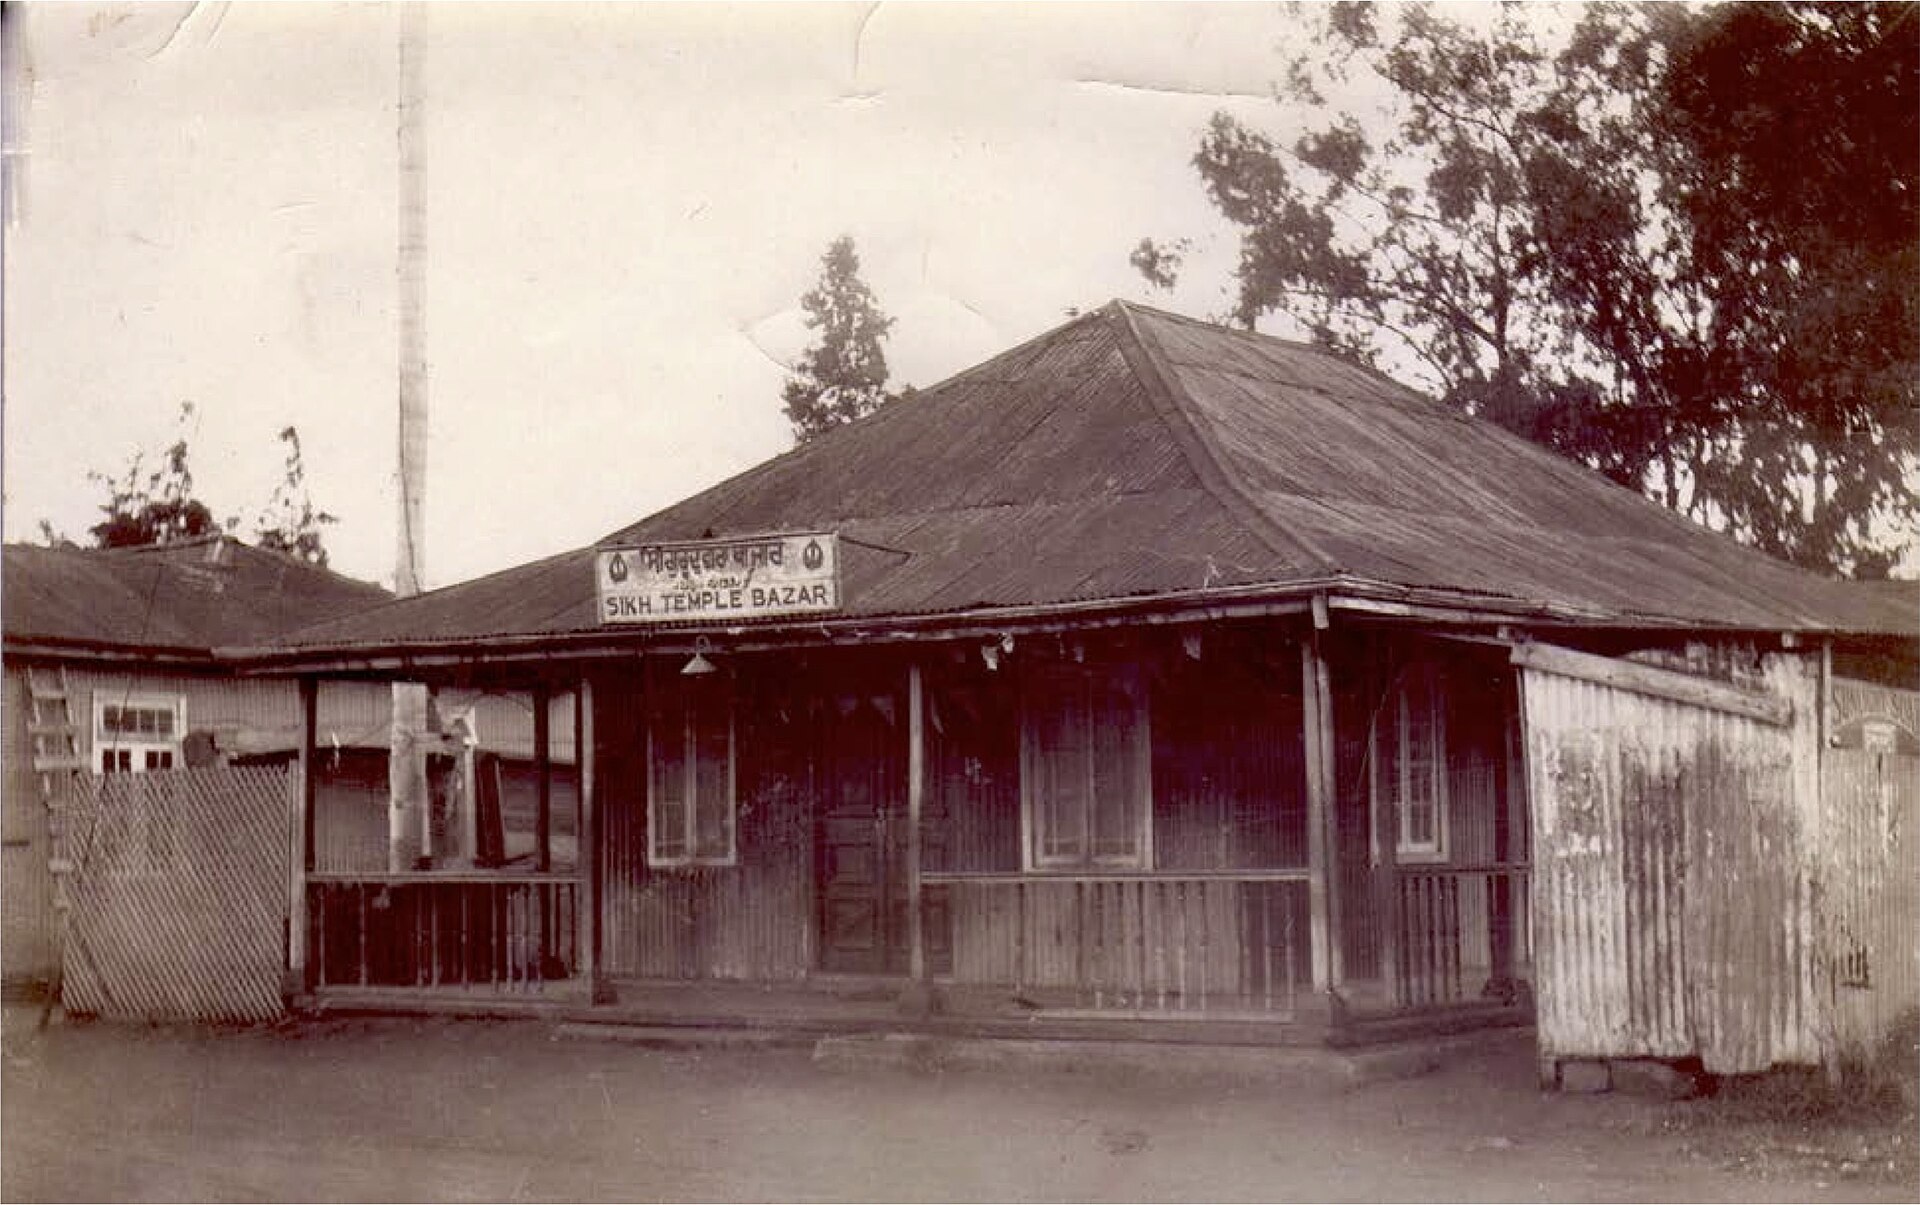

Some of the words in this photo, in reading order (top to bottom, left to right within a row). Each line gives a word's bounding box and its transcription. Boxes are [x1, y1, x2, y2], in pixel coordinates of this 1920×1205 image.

[606, 596, 652, 616] SIKH
[662, 590, 743, 613] TEMPLE
[751, 585, 828, 608] BAZAR
